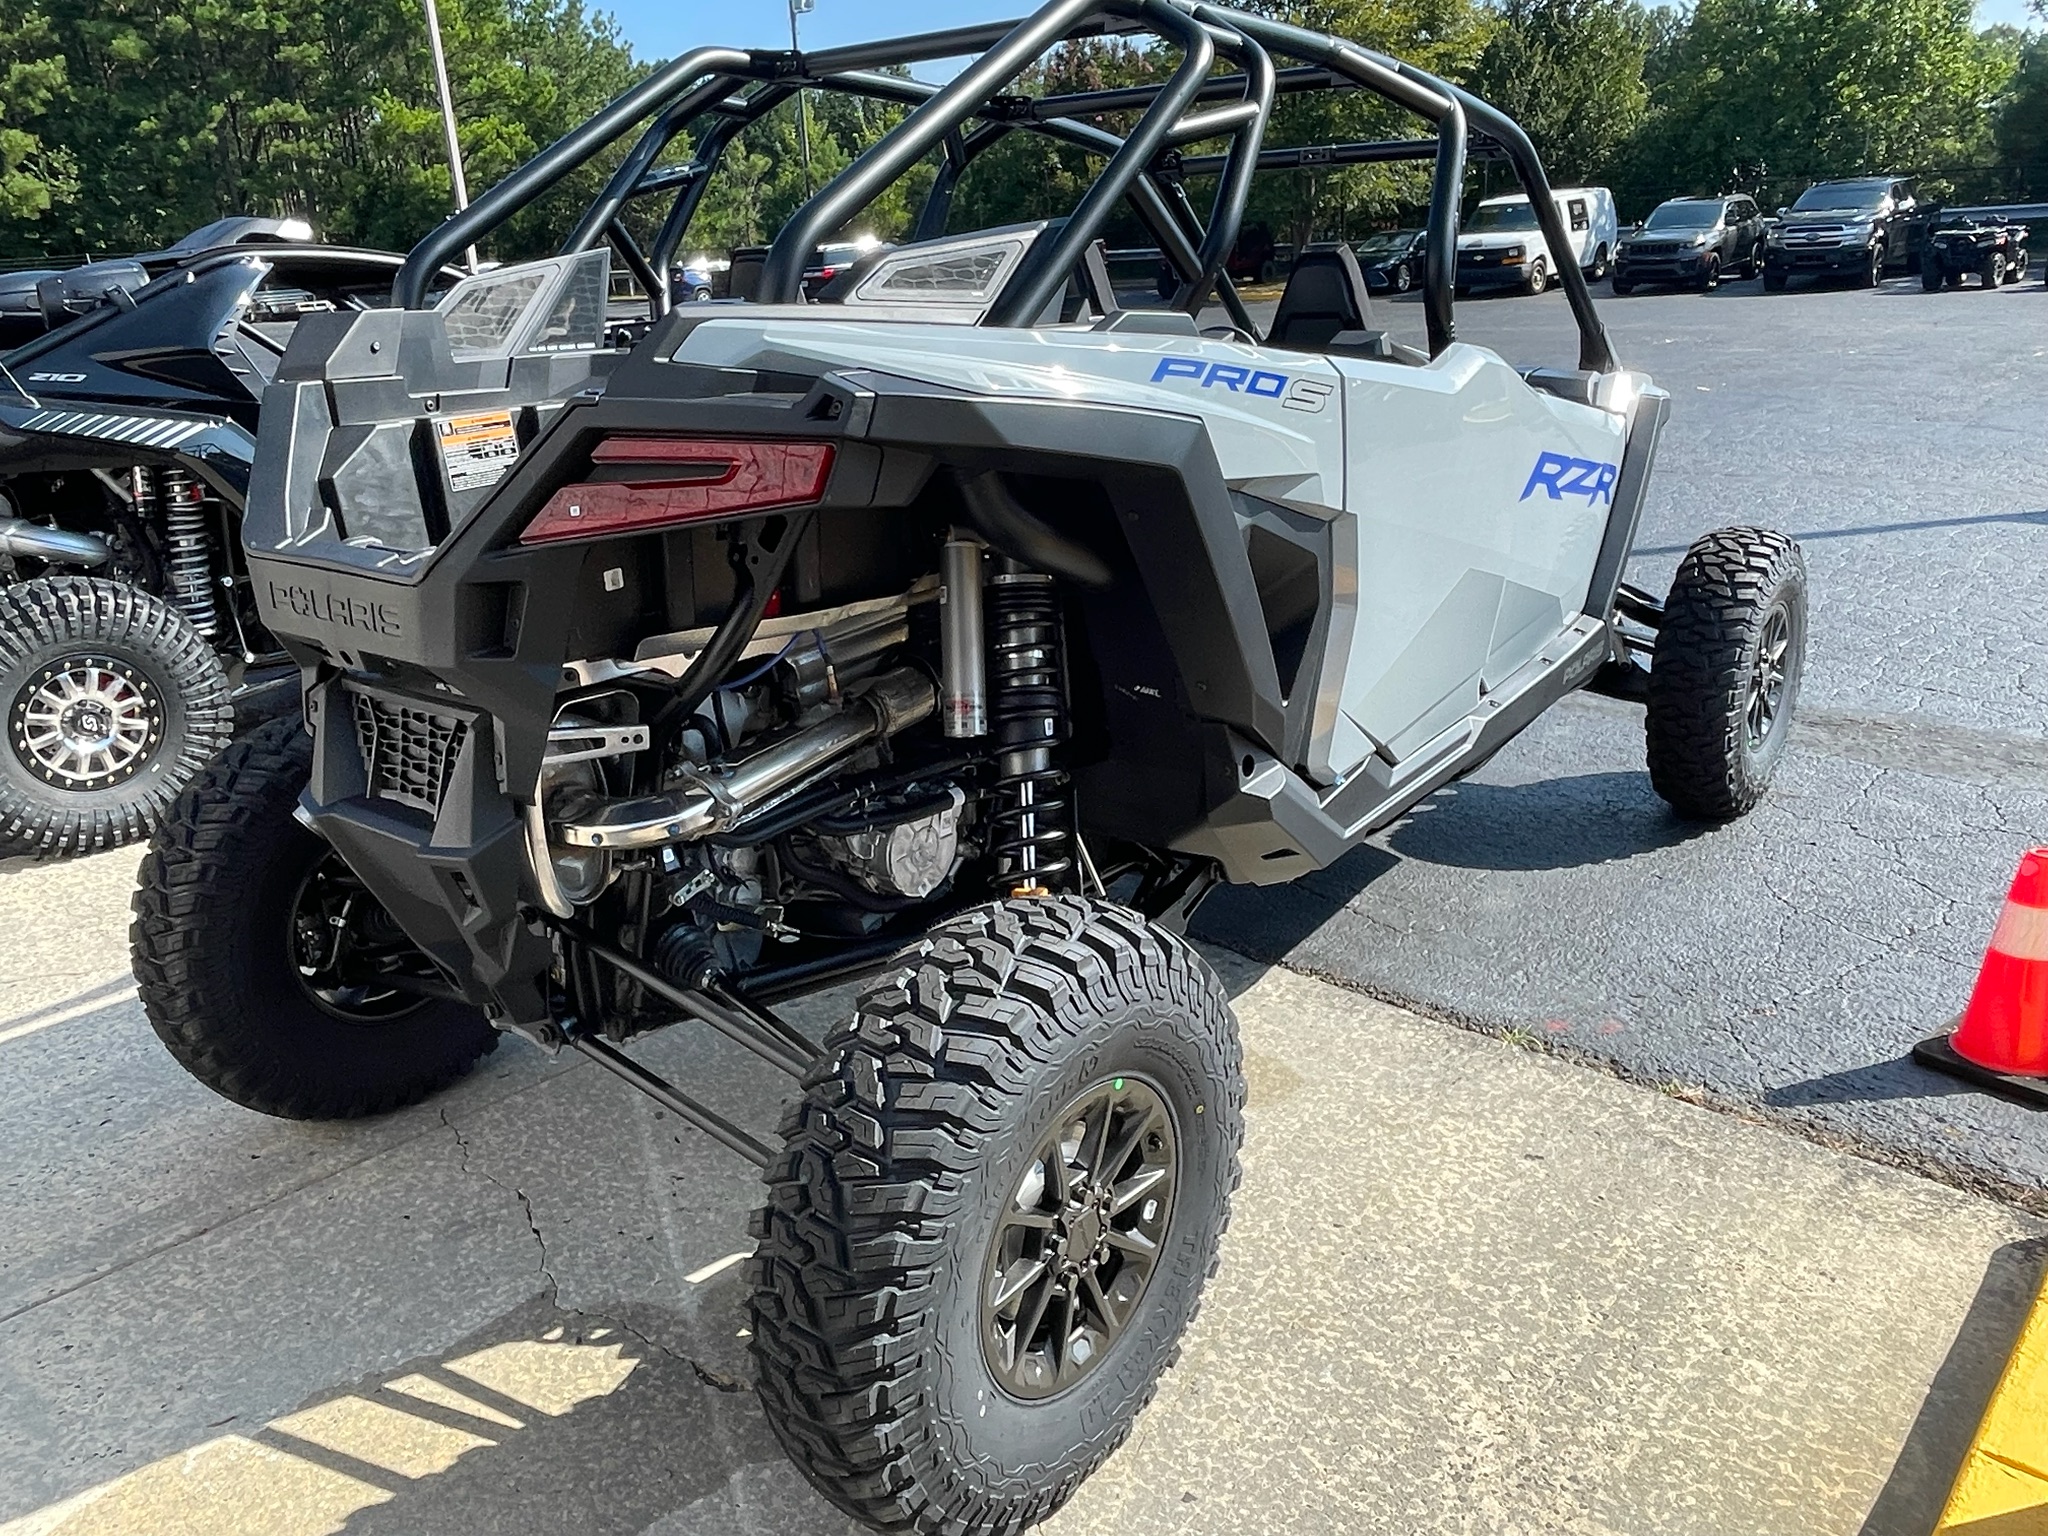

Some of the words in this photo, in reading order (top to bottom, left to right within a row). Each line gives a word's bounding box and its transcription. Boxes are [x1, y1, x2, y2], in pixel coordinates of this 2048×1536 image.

[28, 372, 88, 383] Z10
[1150, 357, 1289, 399] PRO
[1282, 379, 1335, 414] S
[1518, 451, 1617, 508] RZR
[269, 581, 402, 638] POLARIS
